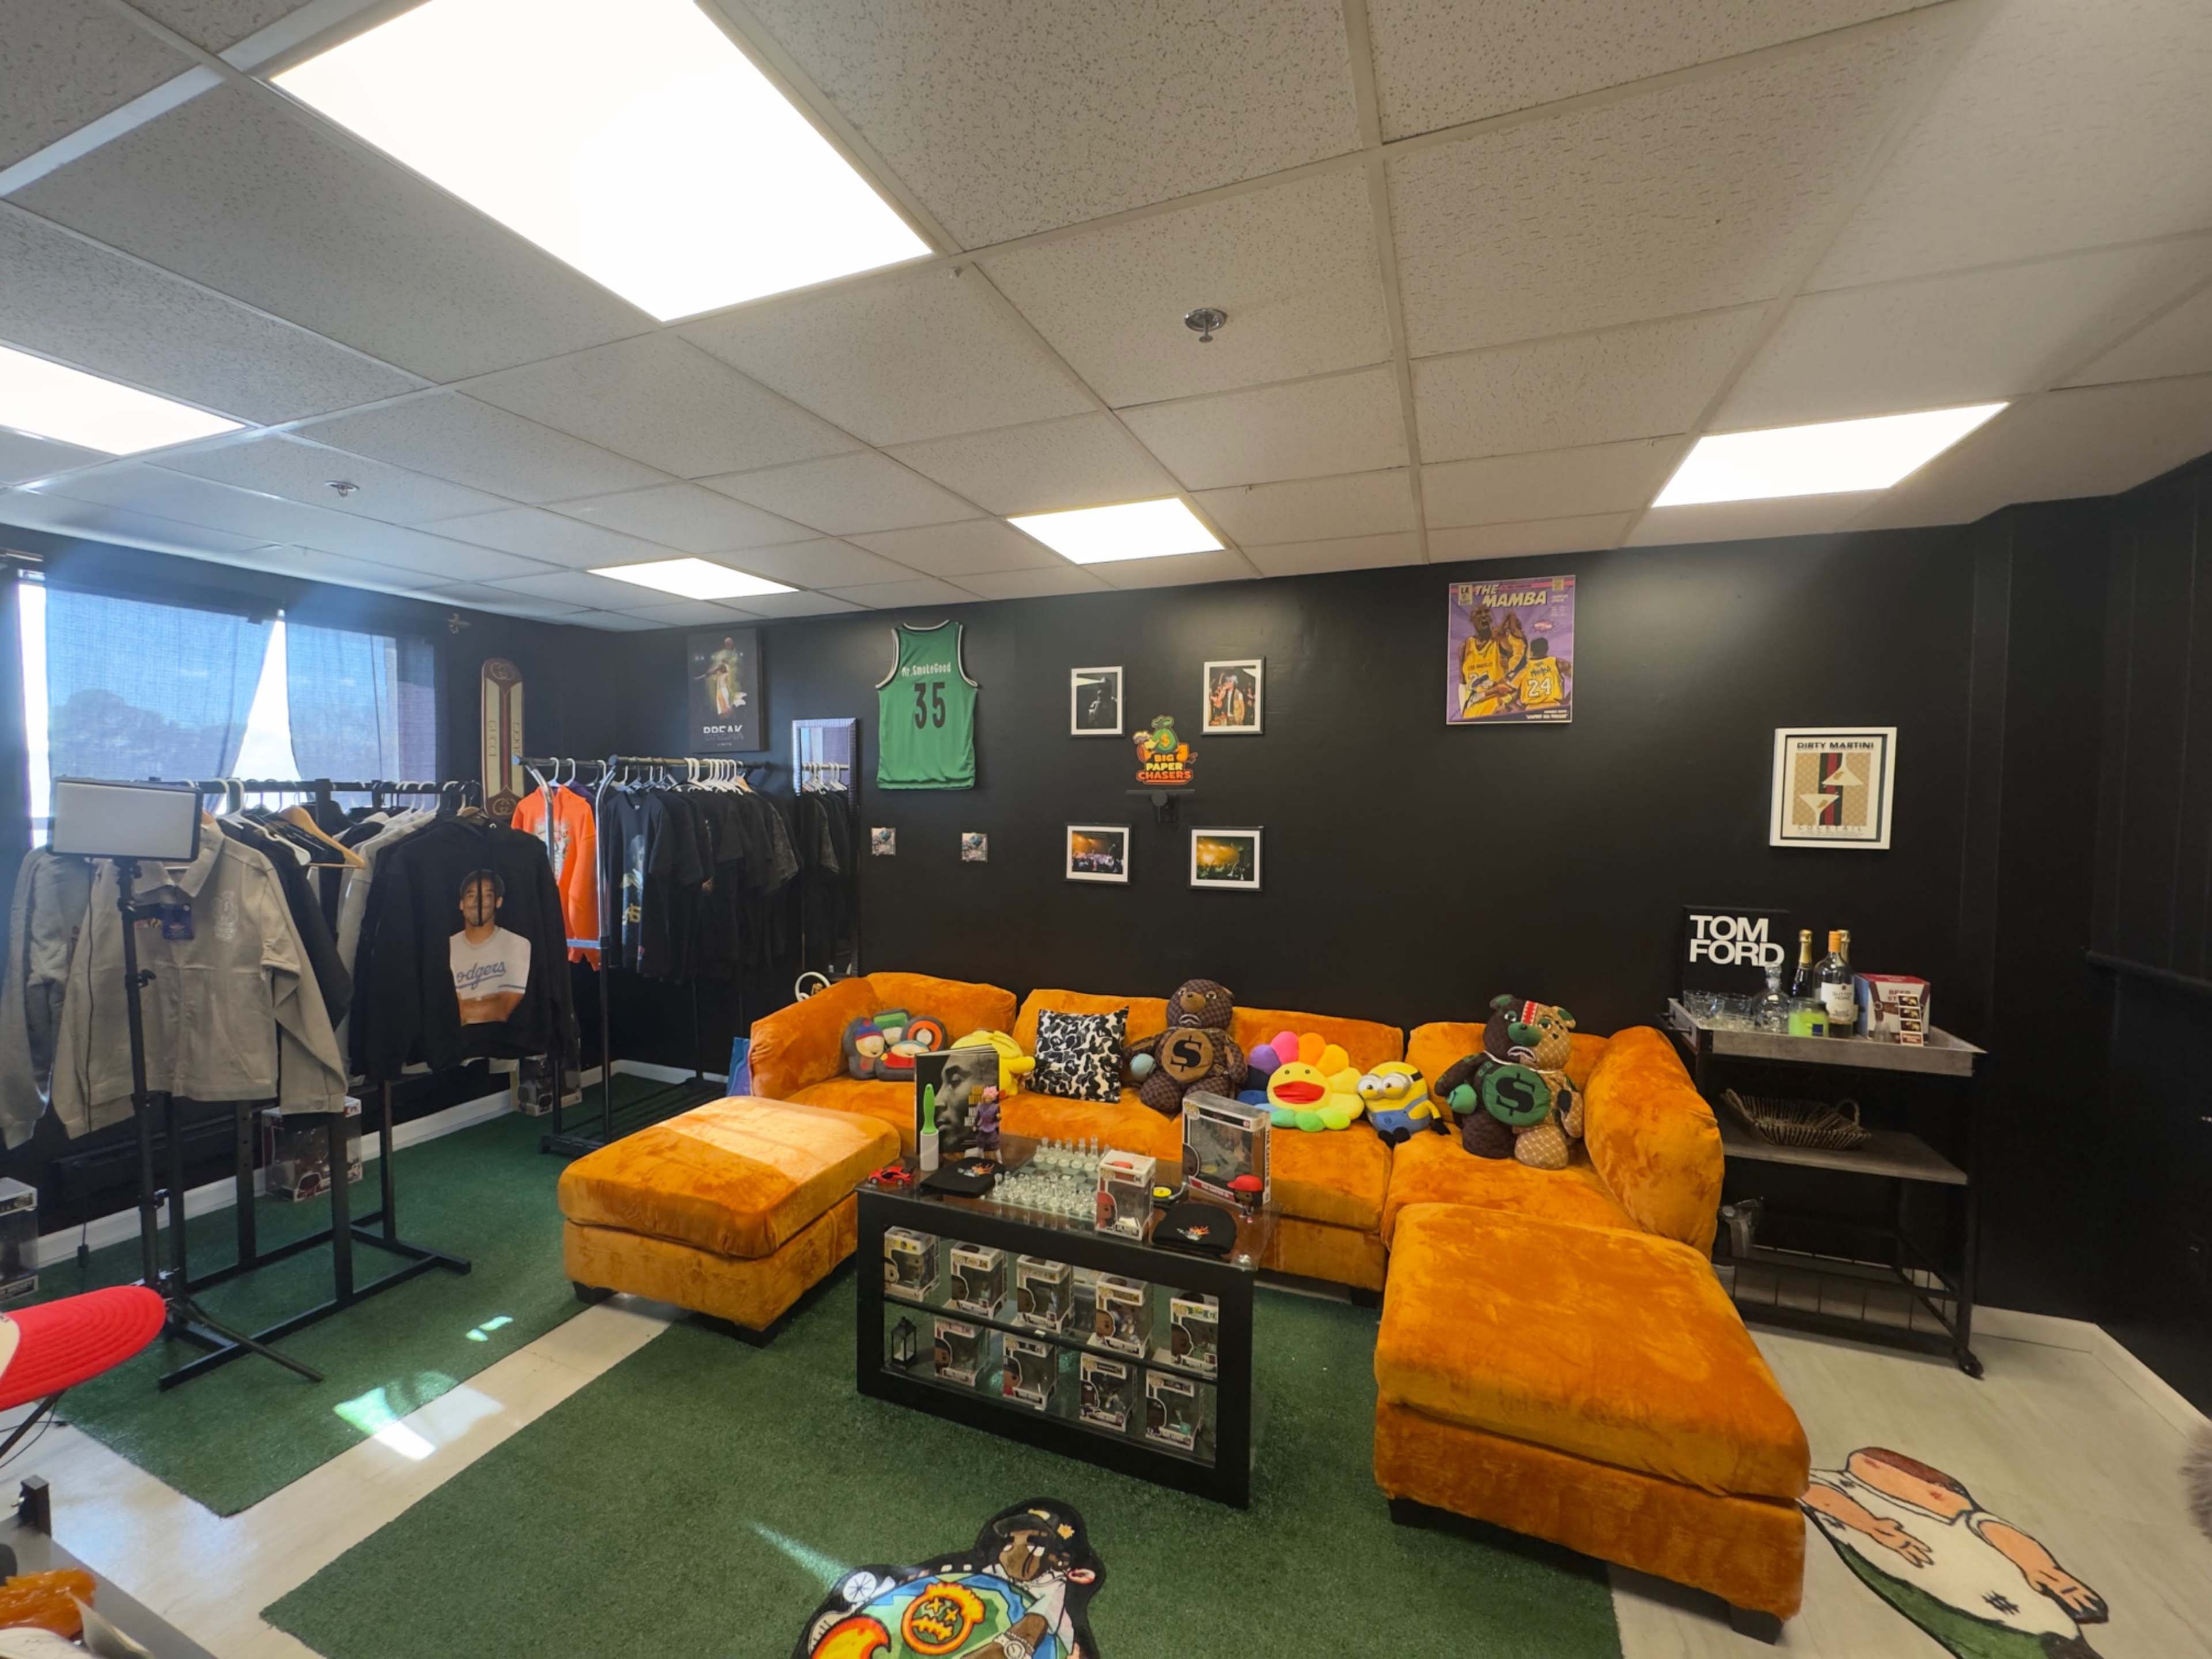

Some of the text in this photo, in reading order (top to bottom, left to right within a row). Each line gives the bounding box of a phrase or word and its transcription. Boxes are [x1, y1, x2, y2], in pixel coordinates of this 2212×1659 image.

[1475, 584, 1499, 595] THE
[1483, 590, 1547, 608] MAMBA
[1528, 677, 1551, 698] 24
[914, 682, 946, 729] 35
[1830, 741, 1874, 749] MARTINI
[1146, 762, 1183, 771] PAPER
[1154, 754, 1175, 762] BIG
[1138, 770, 1191, 779] CHASERS
[1690, 915, 1769, 942] TOM
[1690, 938, 1785, 968] FORD
[456, 961, 507, 991] odgers
